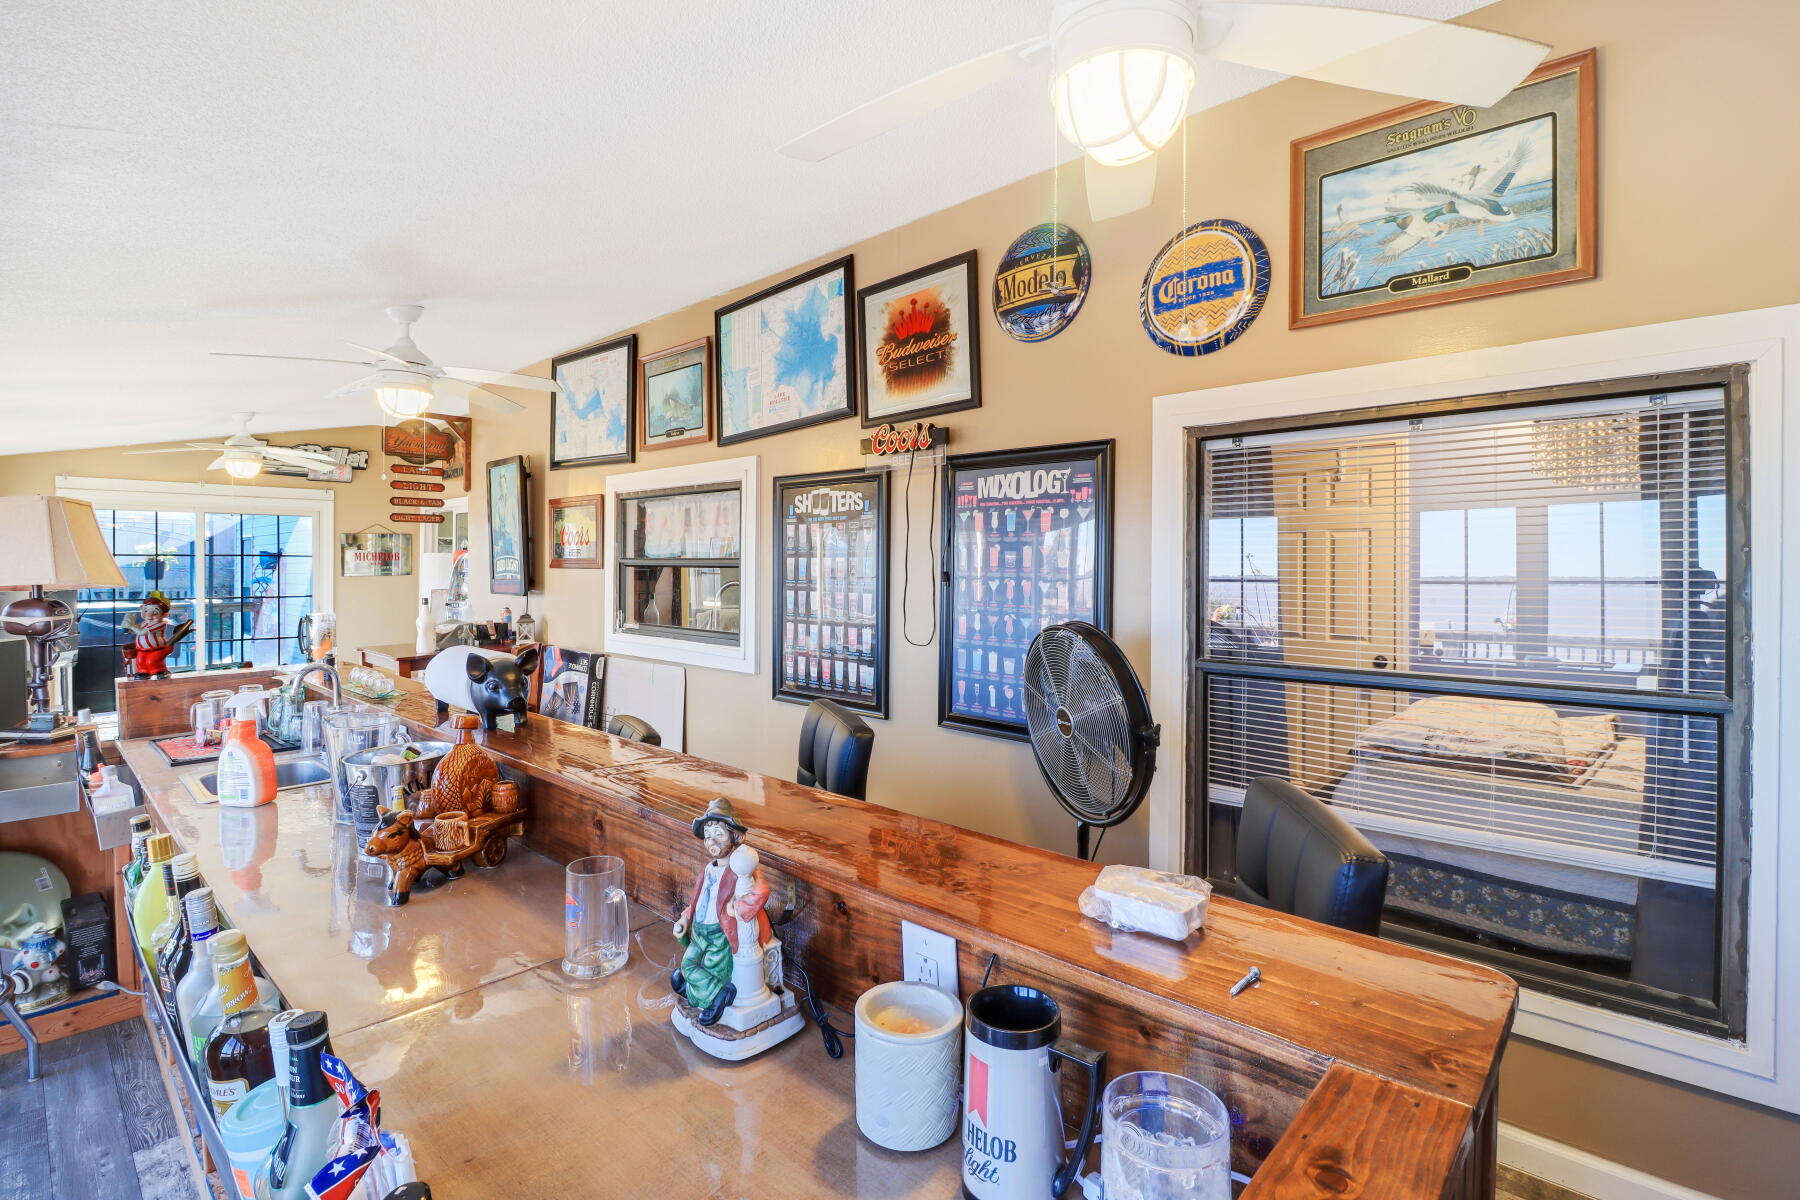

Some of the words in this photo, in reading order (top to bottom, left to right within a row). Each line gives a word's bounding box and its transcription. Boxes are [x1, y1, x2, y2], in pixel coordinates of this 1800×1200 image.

[1386, 119, 1451, 145] Seagram's
[1452, 106, 1477, 127] VO
[1002, 265, 1067, 302] Modelo
[1158, 268, 1236, 305] Corona
[1411, 271, 1450, 286] Mallard
[875, 332, 958, 366] Budweiser
[889, 350, 945, 372] SELECT
[871, 423, 932, 455] Coors
[403, 483, 433, 491] LIGHT
[977, 467, 1072, 499] MIXOLOGY
[560, 525, 590, 547] Coors
[354, 551, 400, 561] MICHELOB
[588, 681, 597, 720] CORNHOLE
